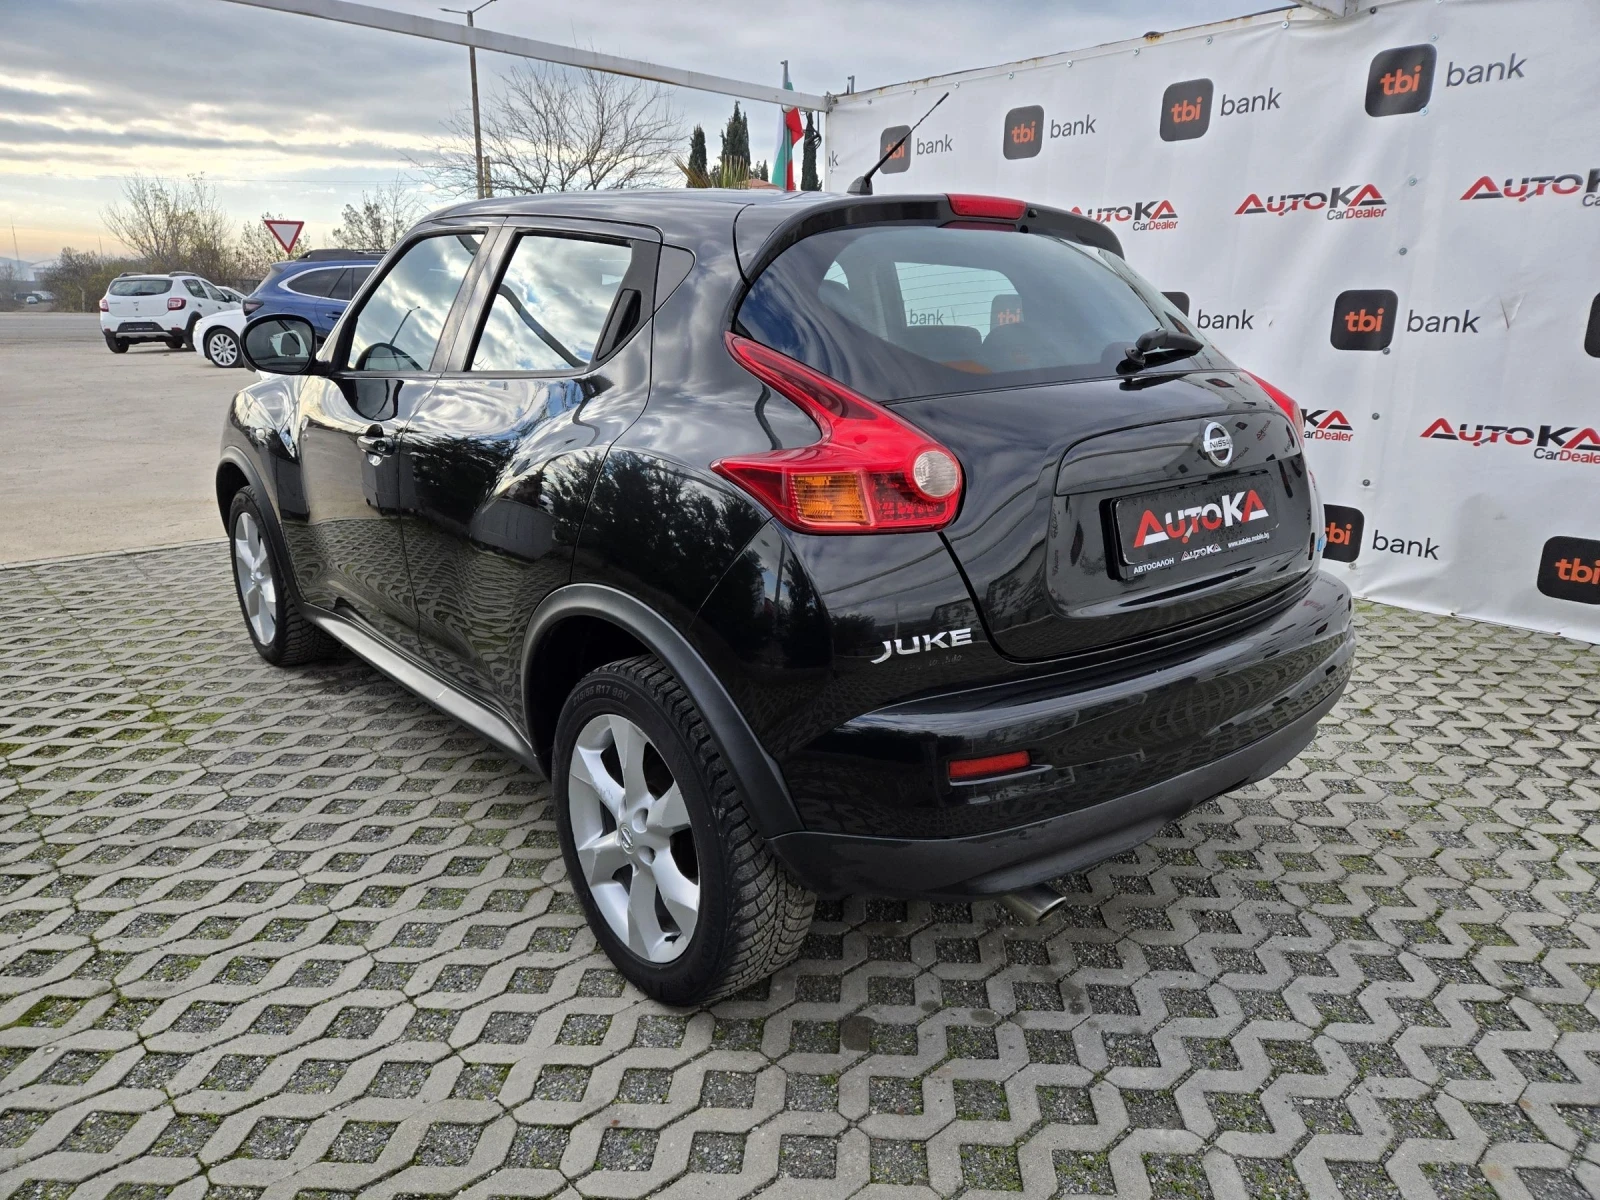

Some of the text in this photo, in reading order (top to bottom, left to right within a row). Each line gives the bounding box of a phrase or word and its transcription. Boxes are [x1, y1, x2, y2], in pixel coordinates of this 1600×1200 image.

[1380, 53, 1528, 95] tbi bank
[1171, 87, 1282, 122] tbi bank
[1011, 114, 1096, 144] tbi bank
[917, 134, 953, 155] bank
[1327, 207, 1387, 220] CarDealer
[1133, 220, 1178, 231] CarDealer
[910, 308, 944, 325] bank
[1197, 309, 1254, 330] bank
[1345, 308, 1481, 333] tbi bank
[1304, 430, 1353, 441] arDealer
[1534, 448, 1600, 464] CarDeale
[1372, 530, 1440, 560] bank
[1134, 557, 1175, 574] АВТОСАЛОН
[1555, 558, 1600, 584] tbi
[870, 627, 973, 664] JUKE
